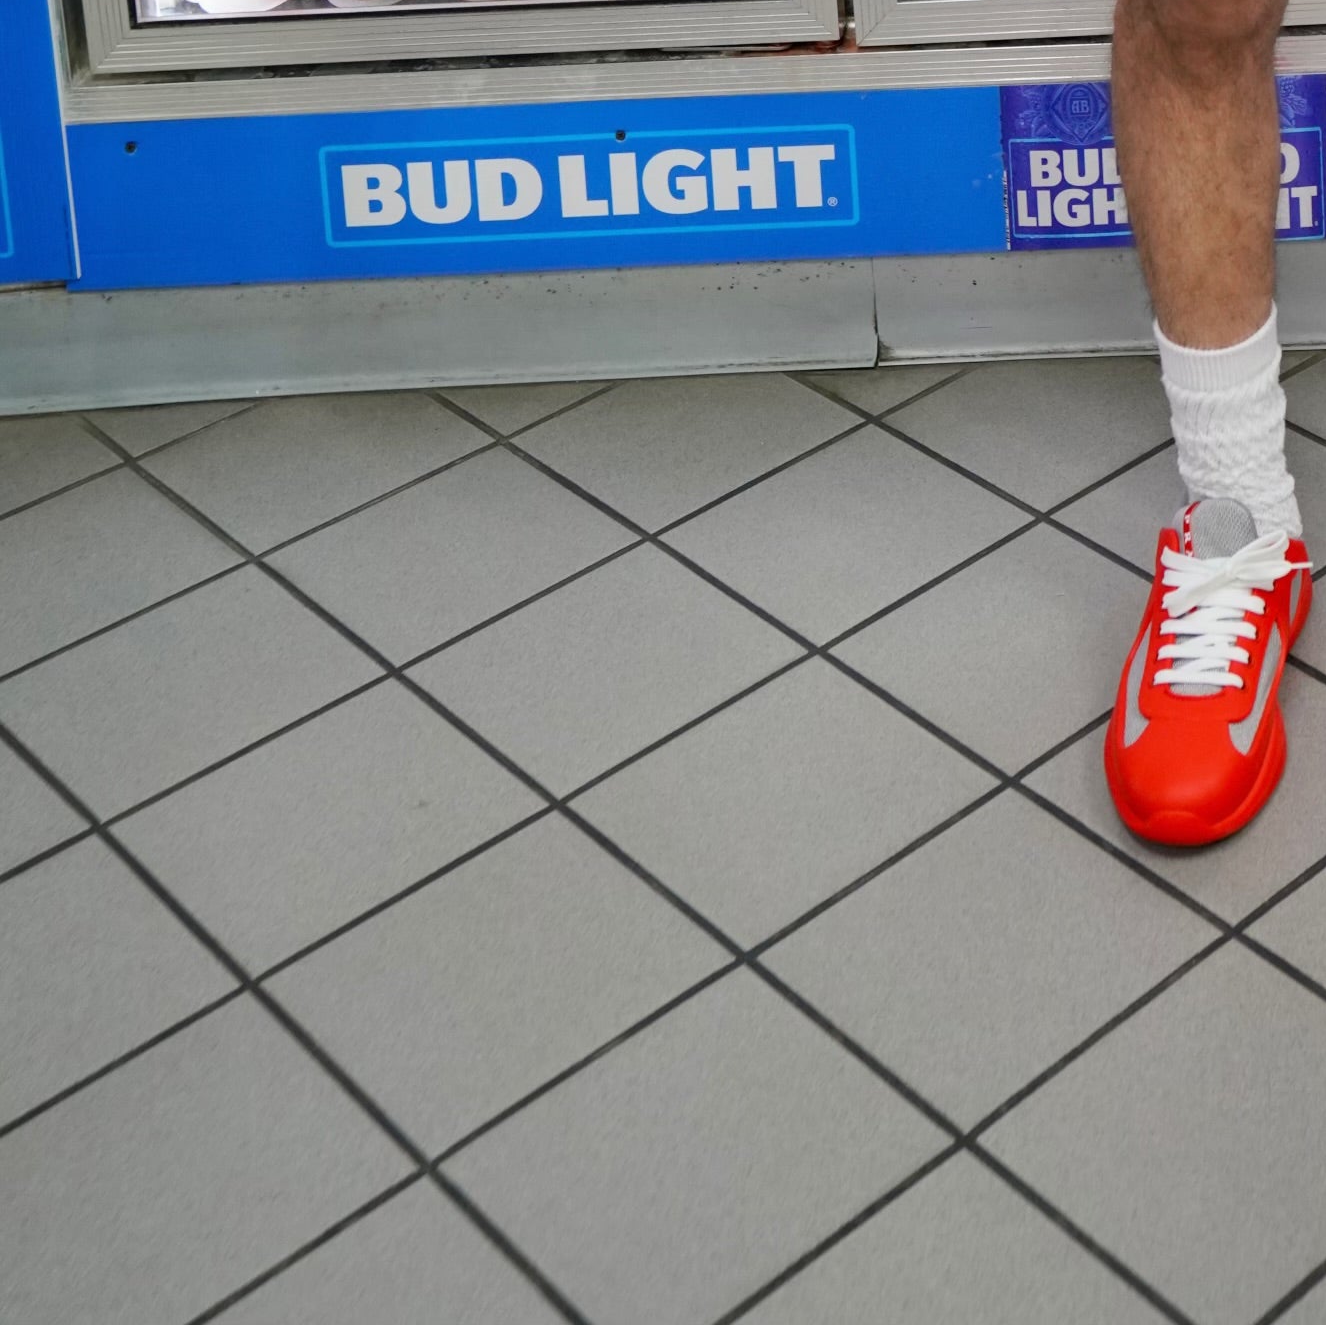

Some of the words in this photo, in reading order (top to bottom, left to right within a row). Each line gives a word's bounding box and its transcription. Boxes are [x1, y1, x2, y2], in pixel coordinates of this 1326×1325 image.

[341, 158, 543, 228] BUD
[558, 144, 836, 219] LIGHT
[1016, 187, 1131, 228] LIGH
